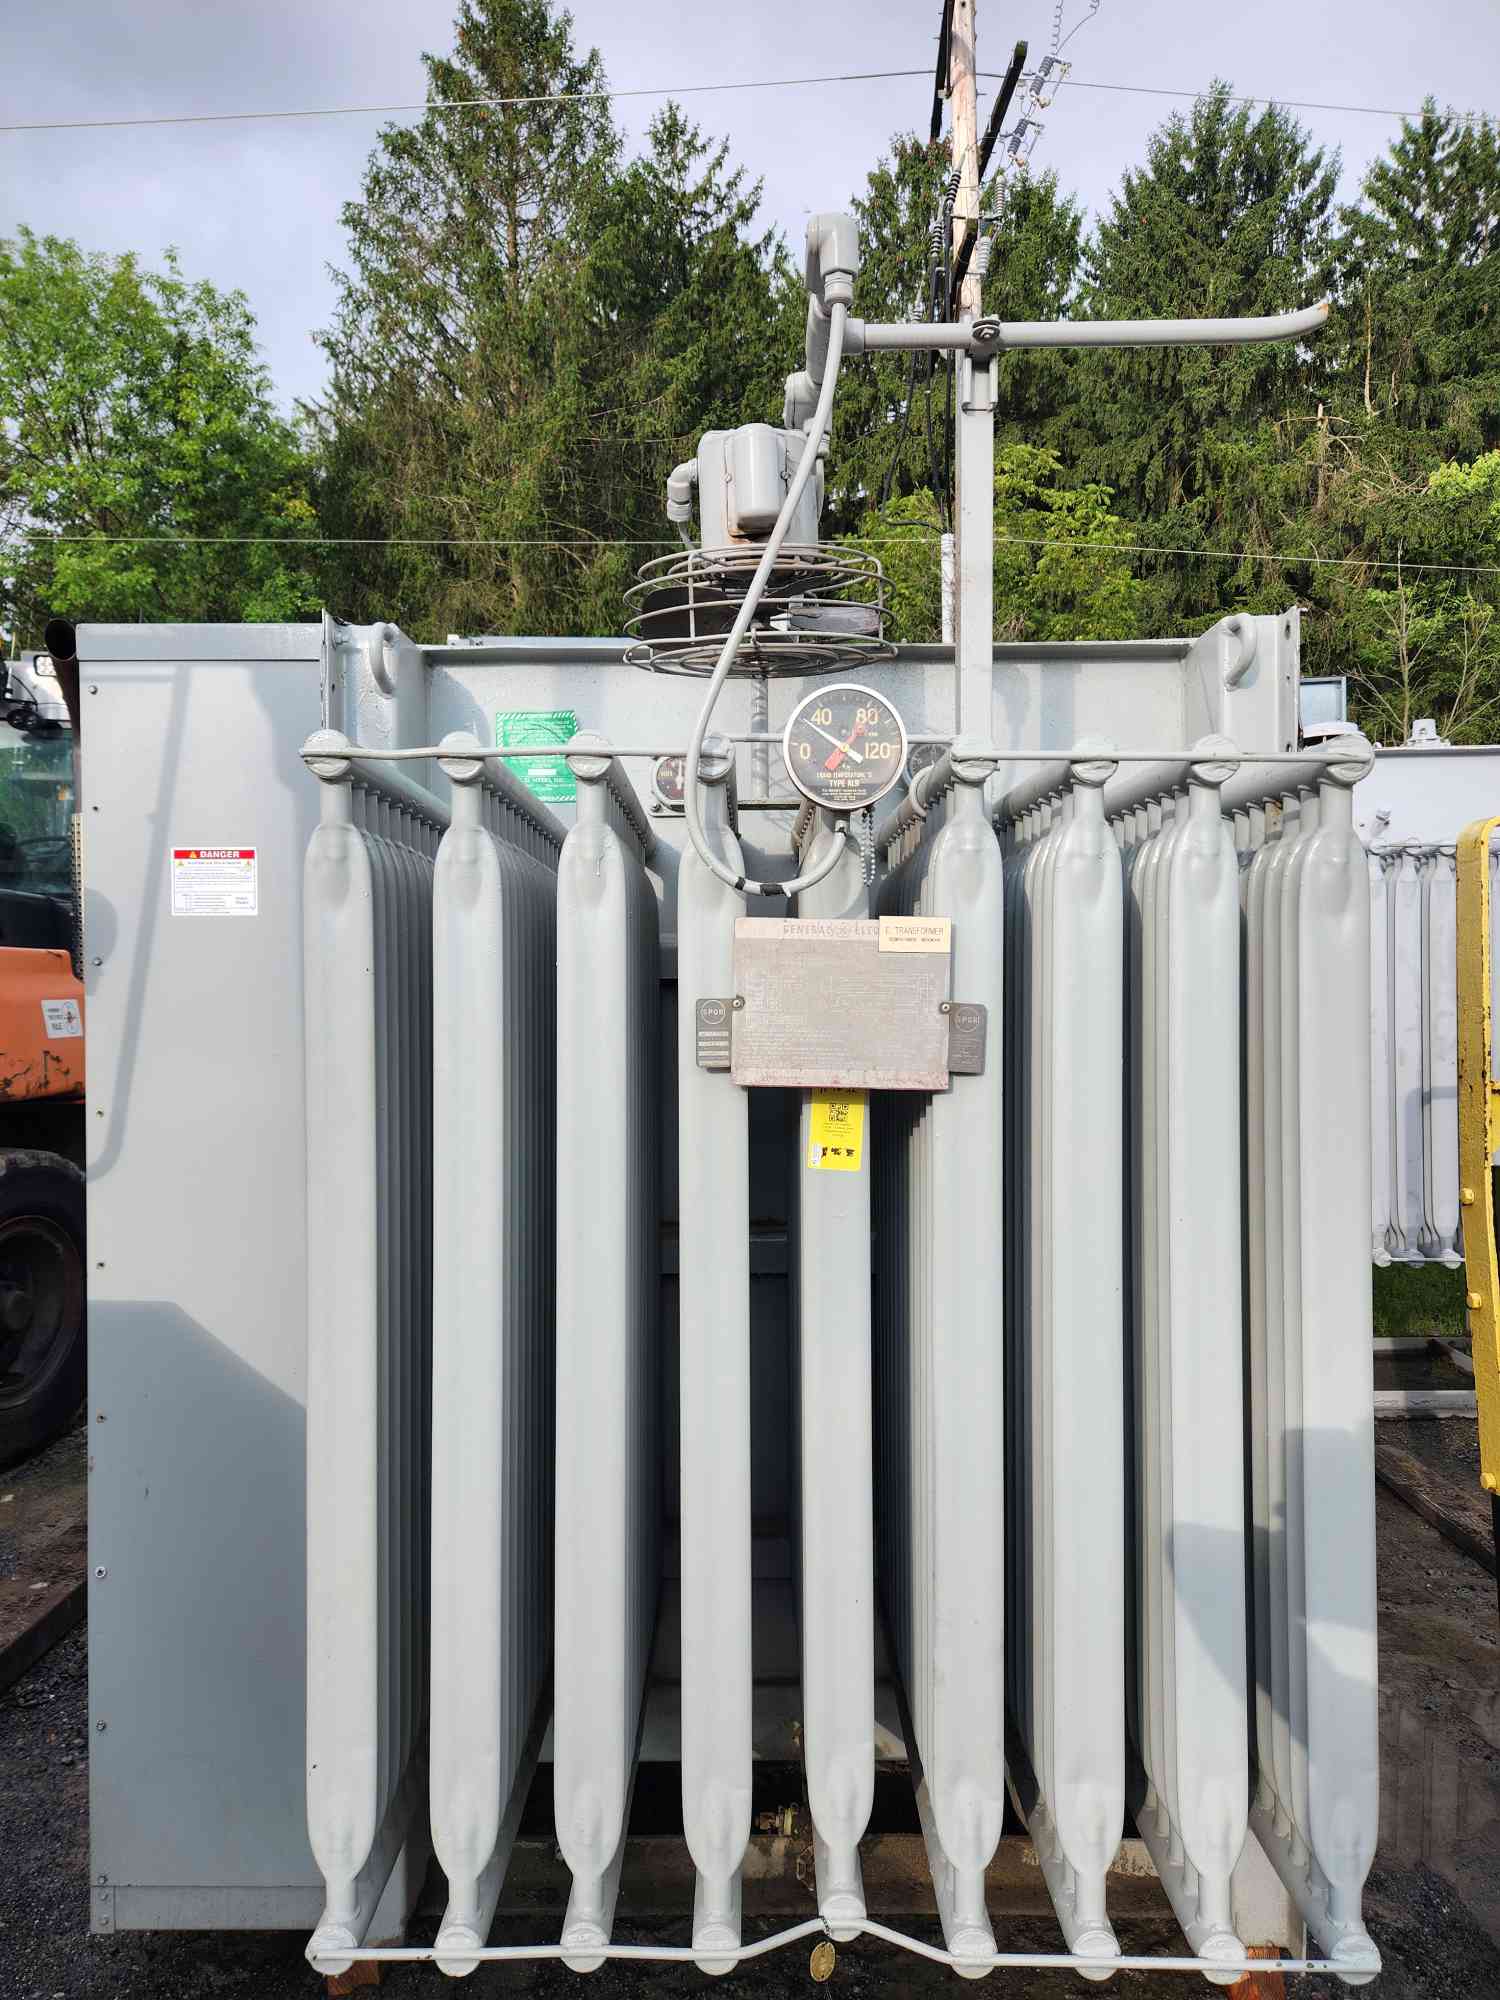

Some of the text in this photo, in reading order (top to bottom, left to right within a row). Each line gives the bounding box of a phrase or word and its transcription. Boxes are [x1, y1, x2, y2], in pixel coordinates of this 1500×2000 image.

[810, 708, 832, 725] 40
[856, 708, 879, 725] 80
[799, 743, 811, 760] 0
[864, 742, 890, 759] 120
[200, 850, 240, 858] DANGER
